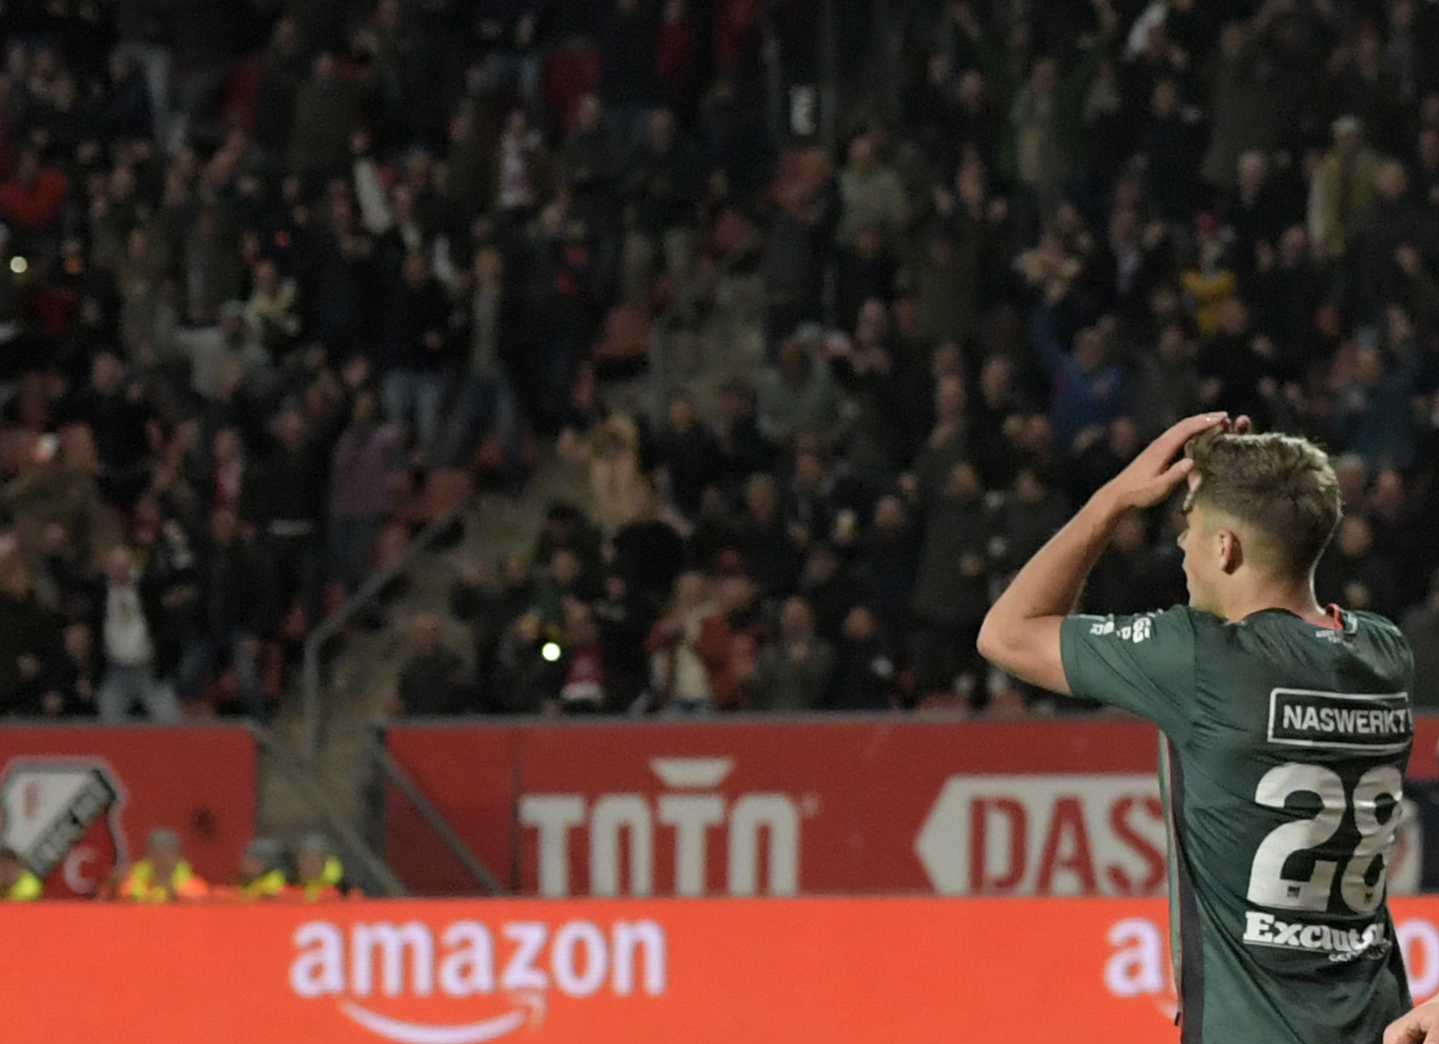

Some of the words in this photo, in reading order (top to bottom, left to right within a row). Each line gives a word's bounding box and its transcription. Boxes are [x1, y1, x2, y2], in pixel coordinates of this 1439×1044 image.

[520, 757, 798, 898] TOTO
[969, 794, 1167, 895] DAS
[1247, 761, 1402, 914] 28
[289, 918, 669, 998] amazon
[1242, 910, 1393, 953] Exclut
